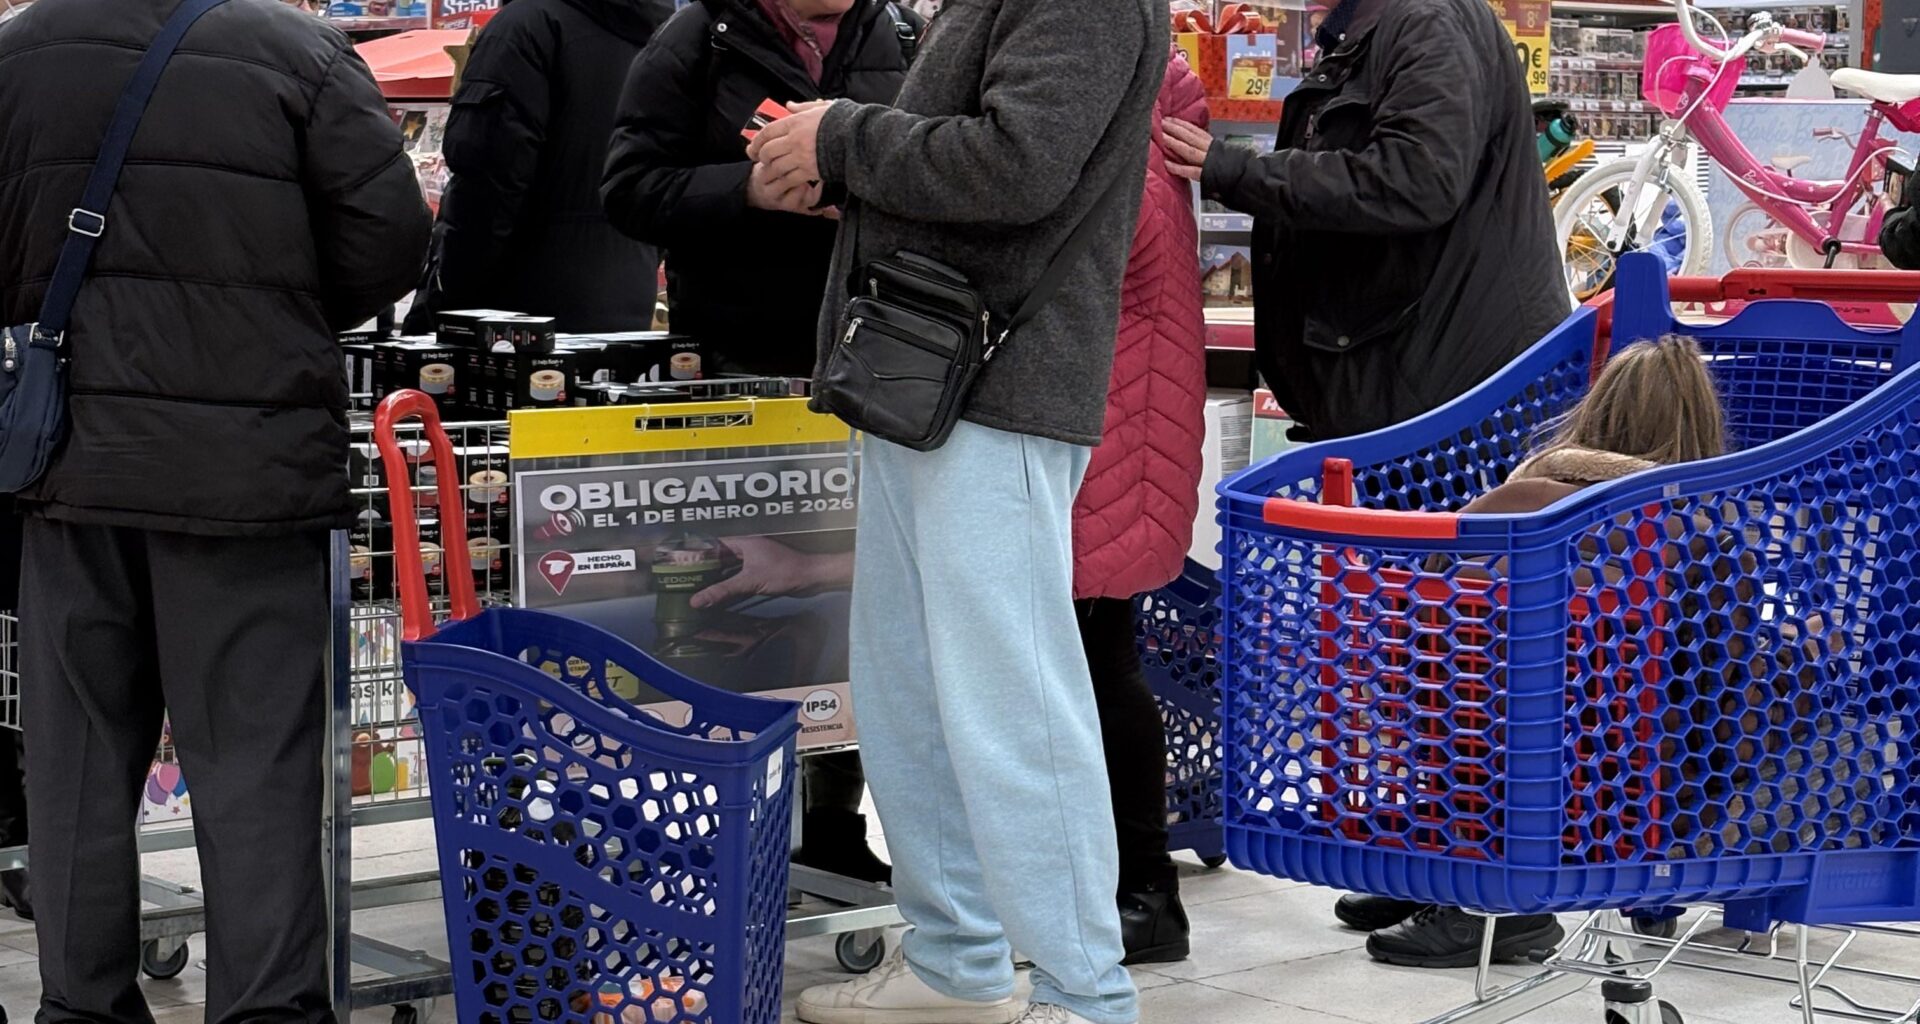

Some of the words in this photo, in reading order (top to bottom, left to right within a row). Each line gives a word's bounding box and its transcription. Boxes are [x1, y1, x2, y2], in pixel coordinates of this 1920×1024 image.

[540, 467, 856, 511] OBLIGATORIO
[593, 513, 620, 528] EL
[626, 511, 637, 526] 1
[644, 509, 675, 524] DE
[682, 503, 759, 521] ENERO
[765, 501, 794, 516] DE
[801, 497, 855, 513] 2026
[587, 554, 622, 563] HECHO
[593, 560, 632, 569] ESPAÑA
[806, 698, 838, 713] IP54
